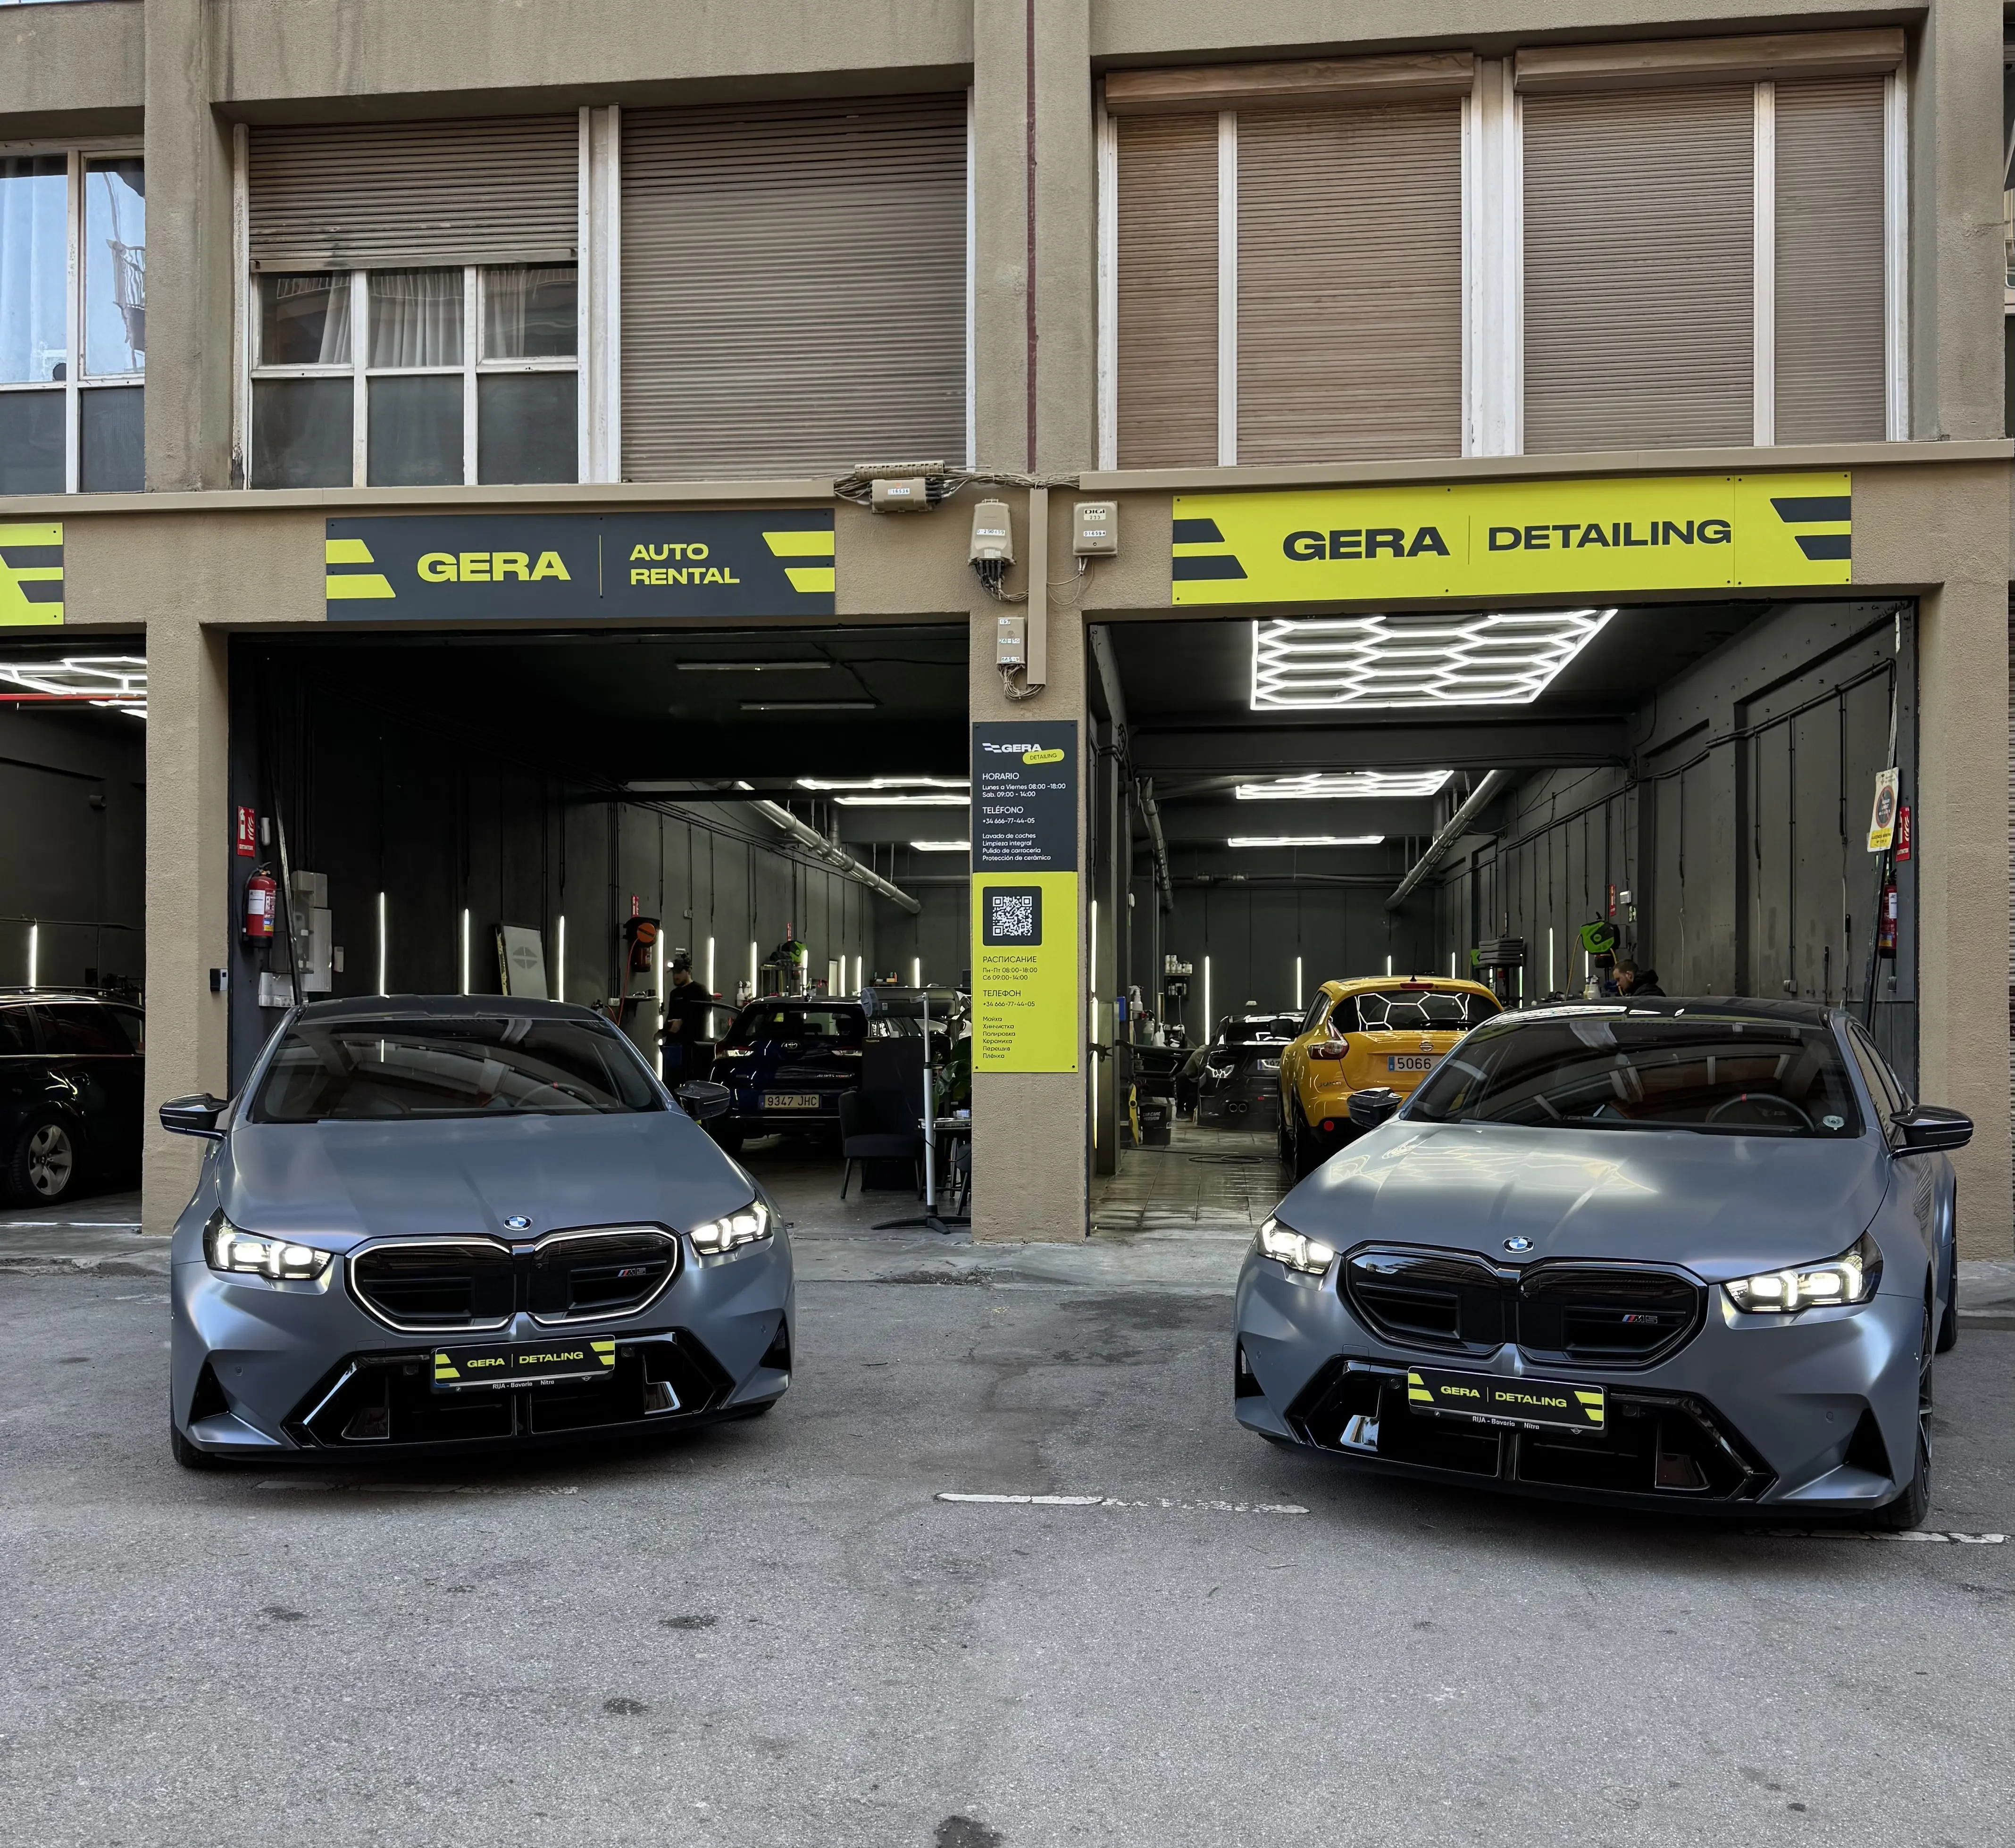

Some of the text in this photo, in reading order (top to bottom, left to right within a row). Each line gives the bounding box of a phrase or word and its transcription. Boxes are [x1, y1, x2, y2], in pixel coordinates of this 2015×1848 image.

[1282, 519, 1732, 561] GERA DETAILING
[629, 543, 709, 561] AUTO
[417, 551, 571, 583] GERA
[630, 567, 740, 585] RENTAL
[1001, 744, 1042, 753] GERA
[982, 805, 1024, 814] TELÉFONO
[1397, 1057, 1431, 1069] 5066
[768, 1096, 817, 1106] 9347 JHC
[1632, 1315, 1658, 1324] M5
[467, 1351, 583, 1368] GERA DETALING
[1440, 1385, 1567, 1407] GERA DETALING
[1491, 1418, 1515, 1426] Bavaria
